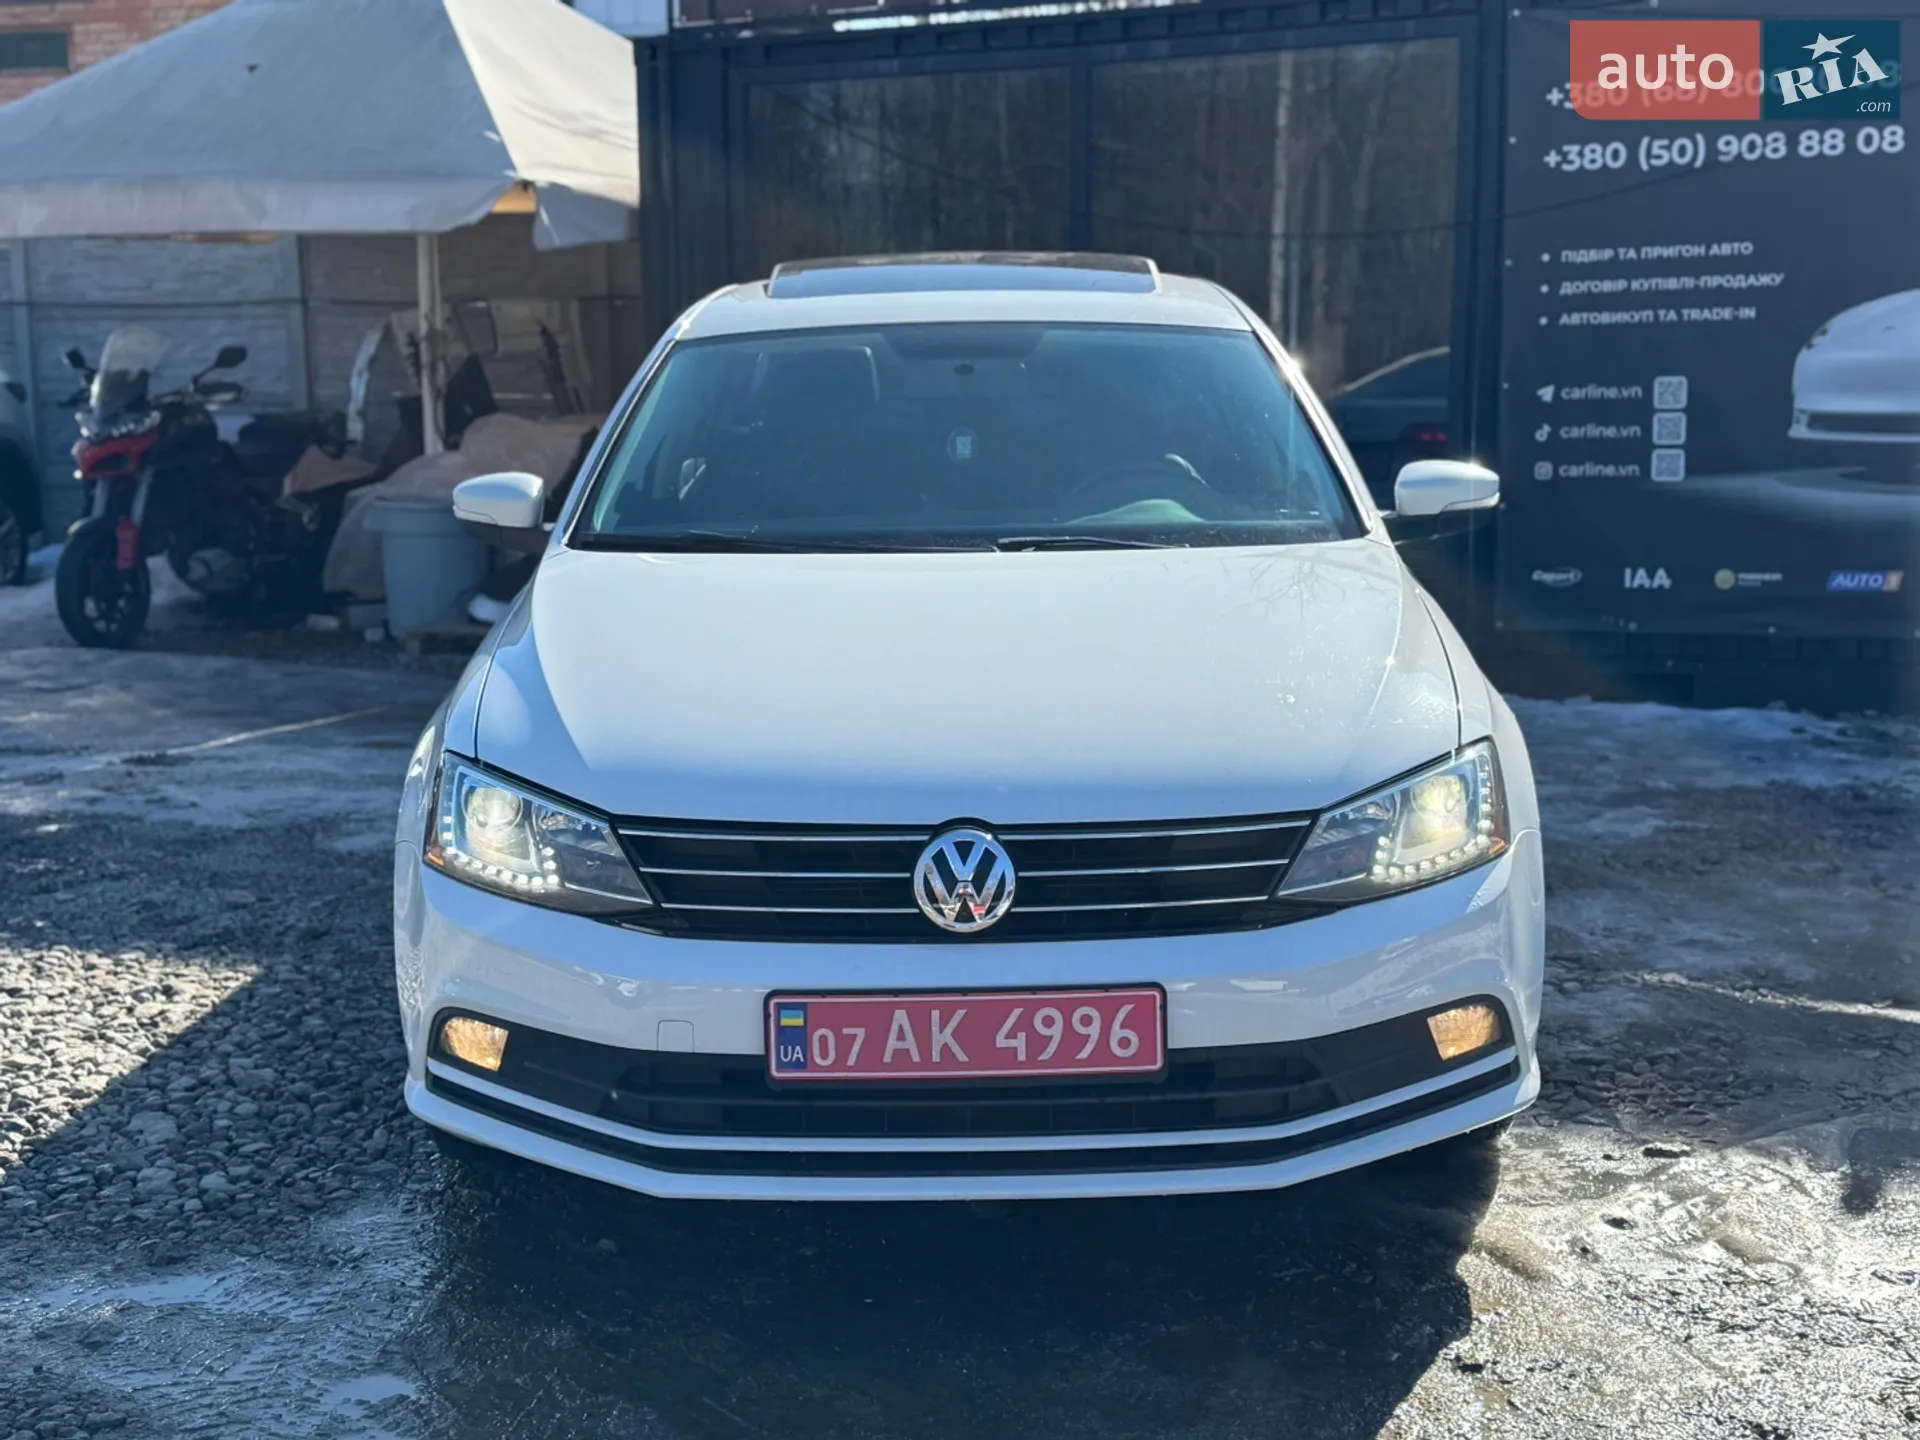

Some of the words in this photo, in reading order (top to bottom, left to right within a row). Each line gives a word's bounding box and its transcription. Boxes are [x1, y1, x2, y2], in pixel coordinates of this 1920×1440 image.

[1543, 142, 1627, 171] +380
[1638, 133, 1706, 171] (50)
[1717, 131, 1787, 162] 908
[1797, 128, 1846, 157] 88
[1856, 125, 1905, 154] 08
[1617, 248, 1638, 261] ТА
[1640, 244, 1706, 260] ПРИГОН
[1709, 242, 1754, 257] АВТО
[1559, 279, 1628, 296] ДОГОВІР
[1558, 311, 1655, 326] АВТОВИКУП
[1657, 309, 1678, 322] ТА
[1681, 306, 1757, 321] TRADE-IN
[1560, 383, 1643, 400] carline.vn
[1559, 422, 1642, 439] carline.vn
[1558, 461, 1640, 477] carline.vn
[1624, 567, 1672, 589] IAA
[812, 1027, 866, 1067] 07
[883, 1009, 969, 1063] AK
[995, 1004, 1139, 1061] 4996
[780, 1045, 805, 1063] UA
